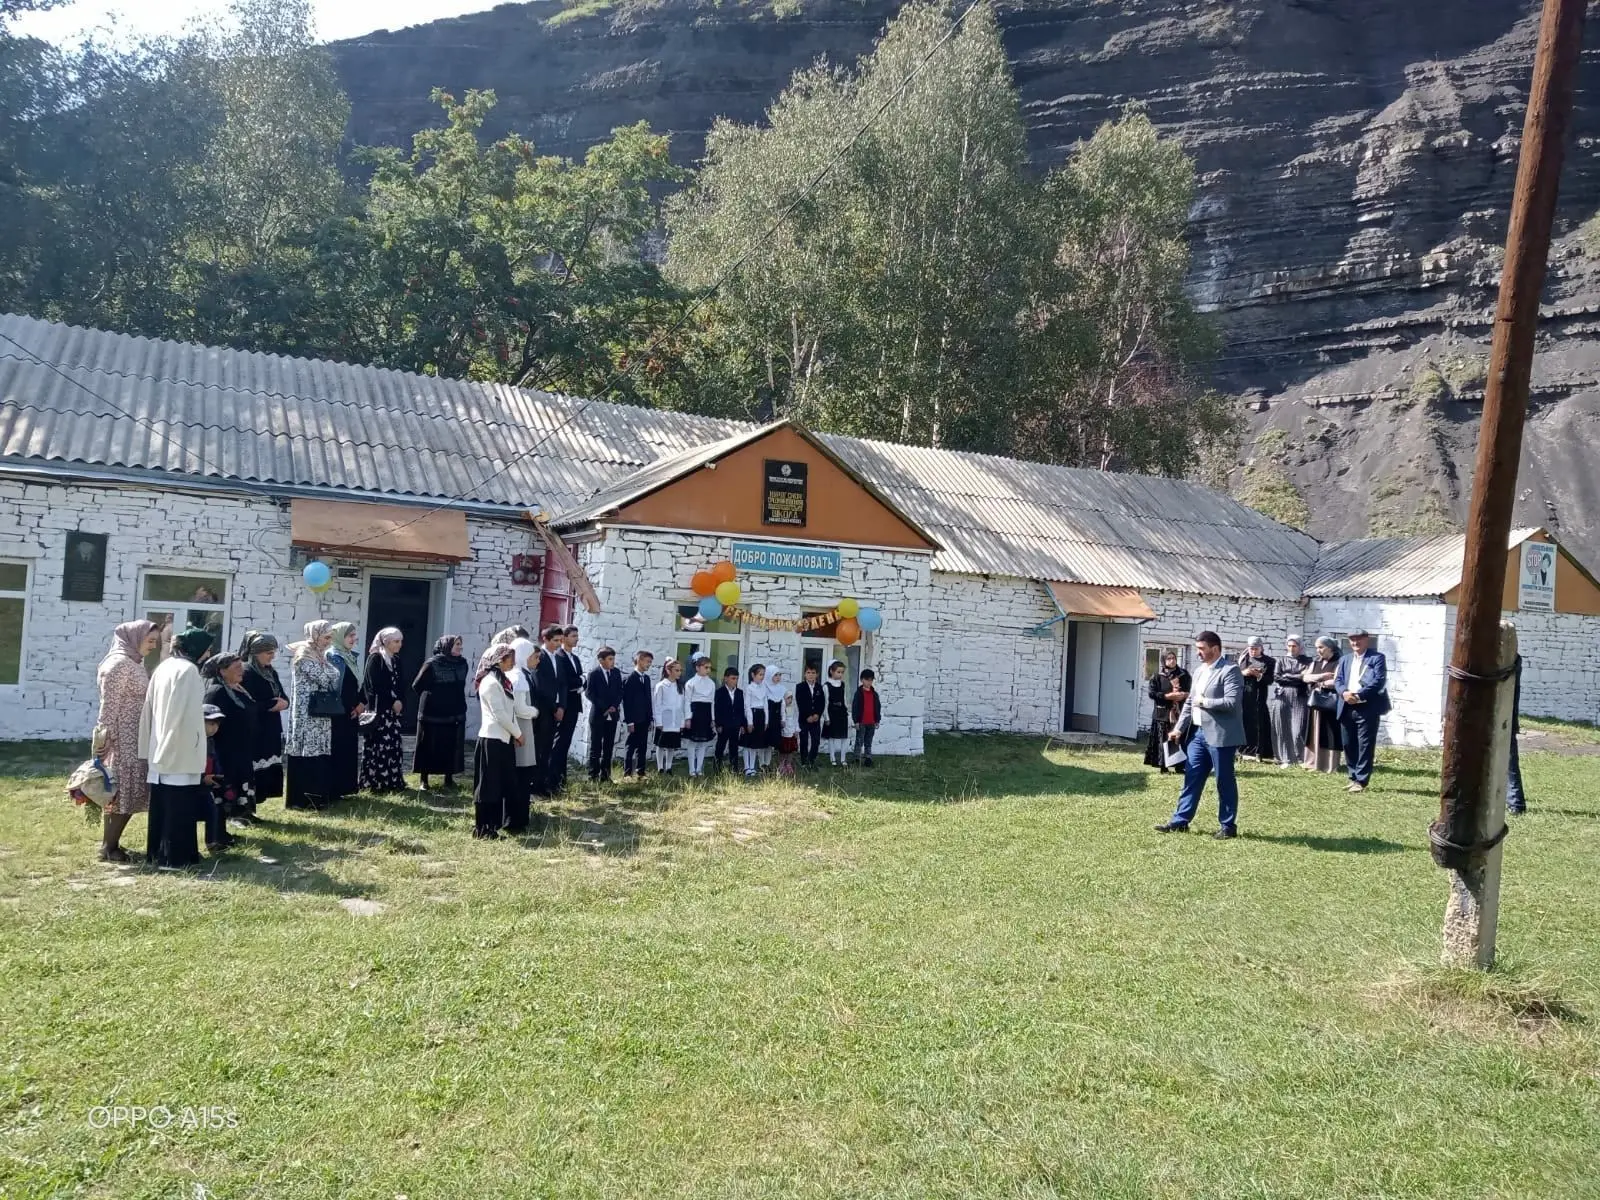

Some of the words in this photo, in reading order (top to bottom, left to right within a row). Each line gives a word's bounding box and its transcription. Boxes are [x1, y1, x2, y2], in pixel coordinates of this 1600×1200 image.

[734, 549, 766, 565] ДОБРО
[769, 552, 833, 570] ПОЖАЛОВАТЬ
[1527, 554, 1542, 567] STOP
